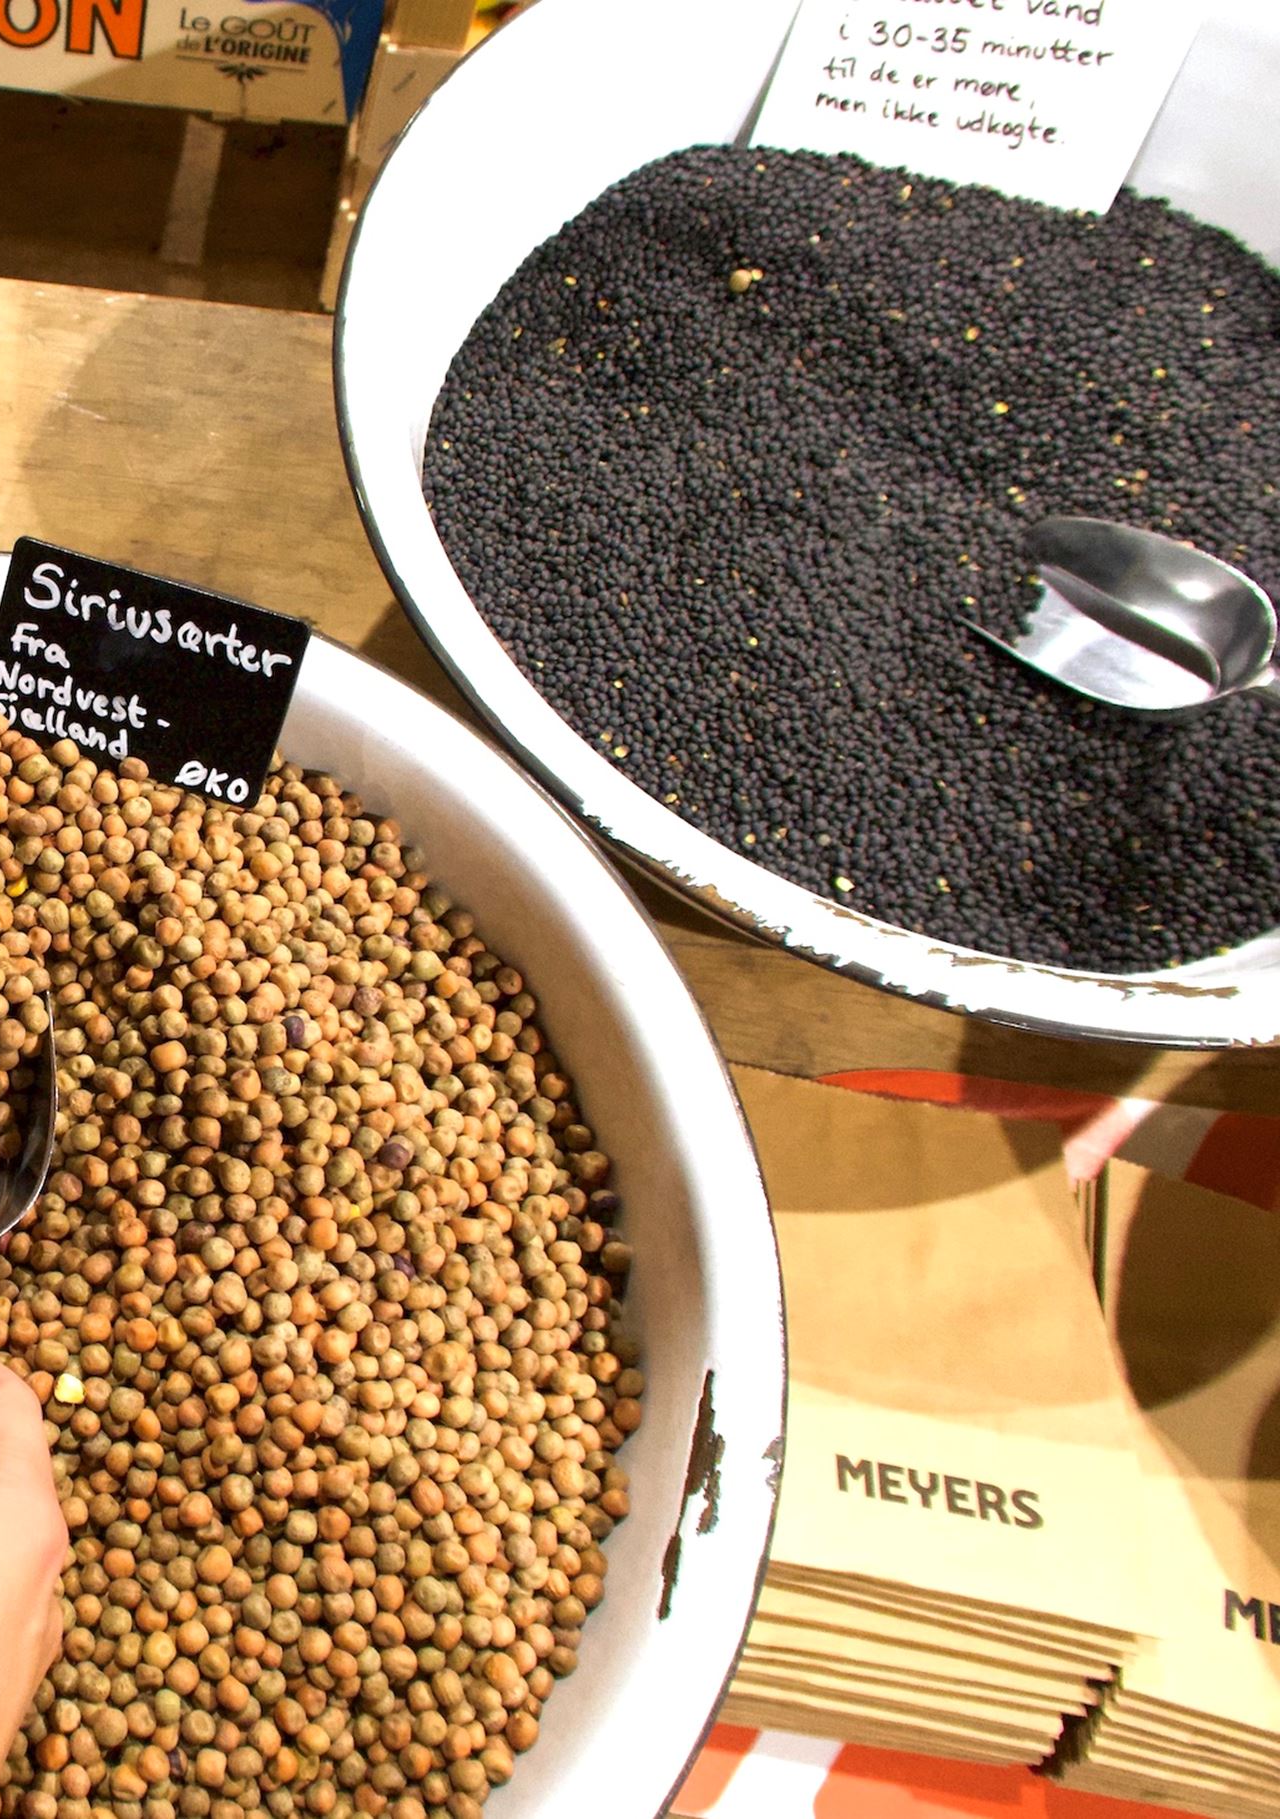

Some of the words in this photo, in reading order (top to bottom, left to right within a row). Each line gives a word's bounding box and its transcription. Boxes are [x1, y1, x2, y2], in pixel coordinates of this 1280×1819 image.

[180, 7, 210, 31] Le
[220, 16, 316, 43] GOÛT
[1026, 0, 1104, 26] vand
[176, 35, 200, 50] de
[204, 36, 311, 63] L'ORIGINE
[839, 14, 850, 40] i
[868, 20, 971, 53] 30-35
[982, 36, 1114, 66] minutter
[823, 57, 856, 80] til
[870, 61, 899, 84] de
[913, 74, 937, 89] er
[816, 92, 866, 112] men
[882, 99, 939, 127] ikke
[11, 622, 70, 669] Fra
[835, 1453, 1044, 1530] MEYERS
